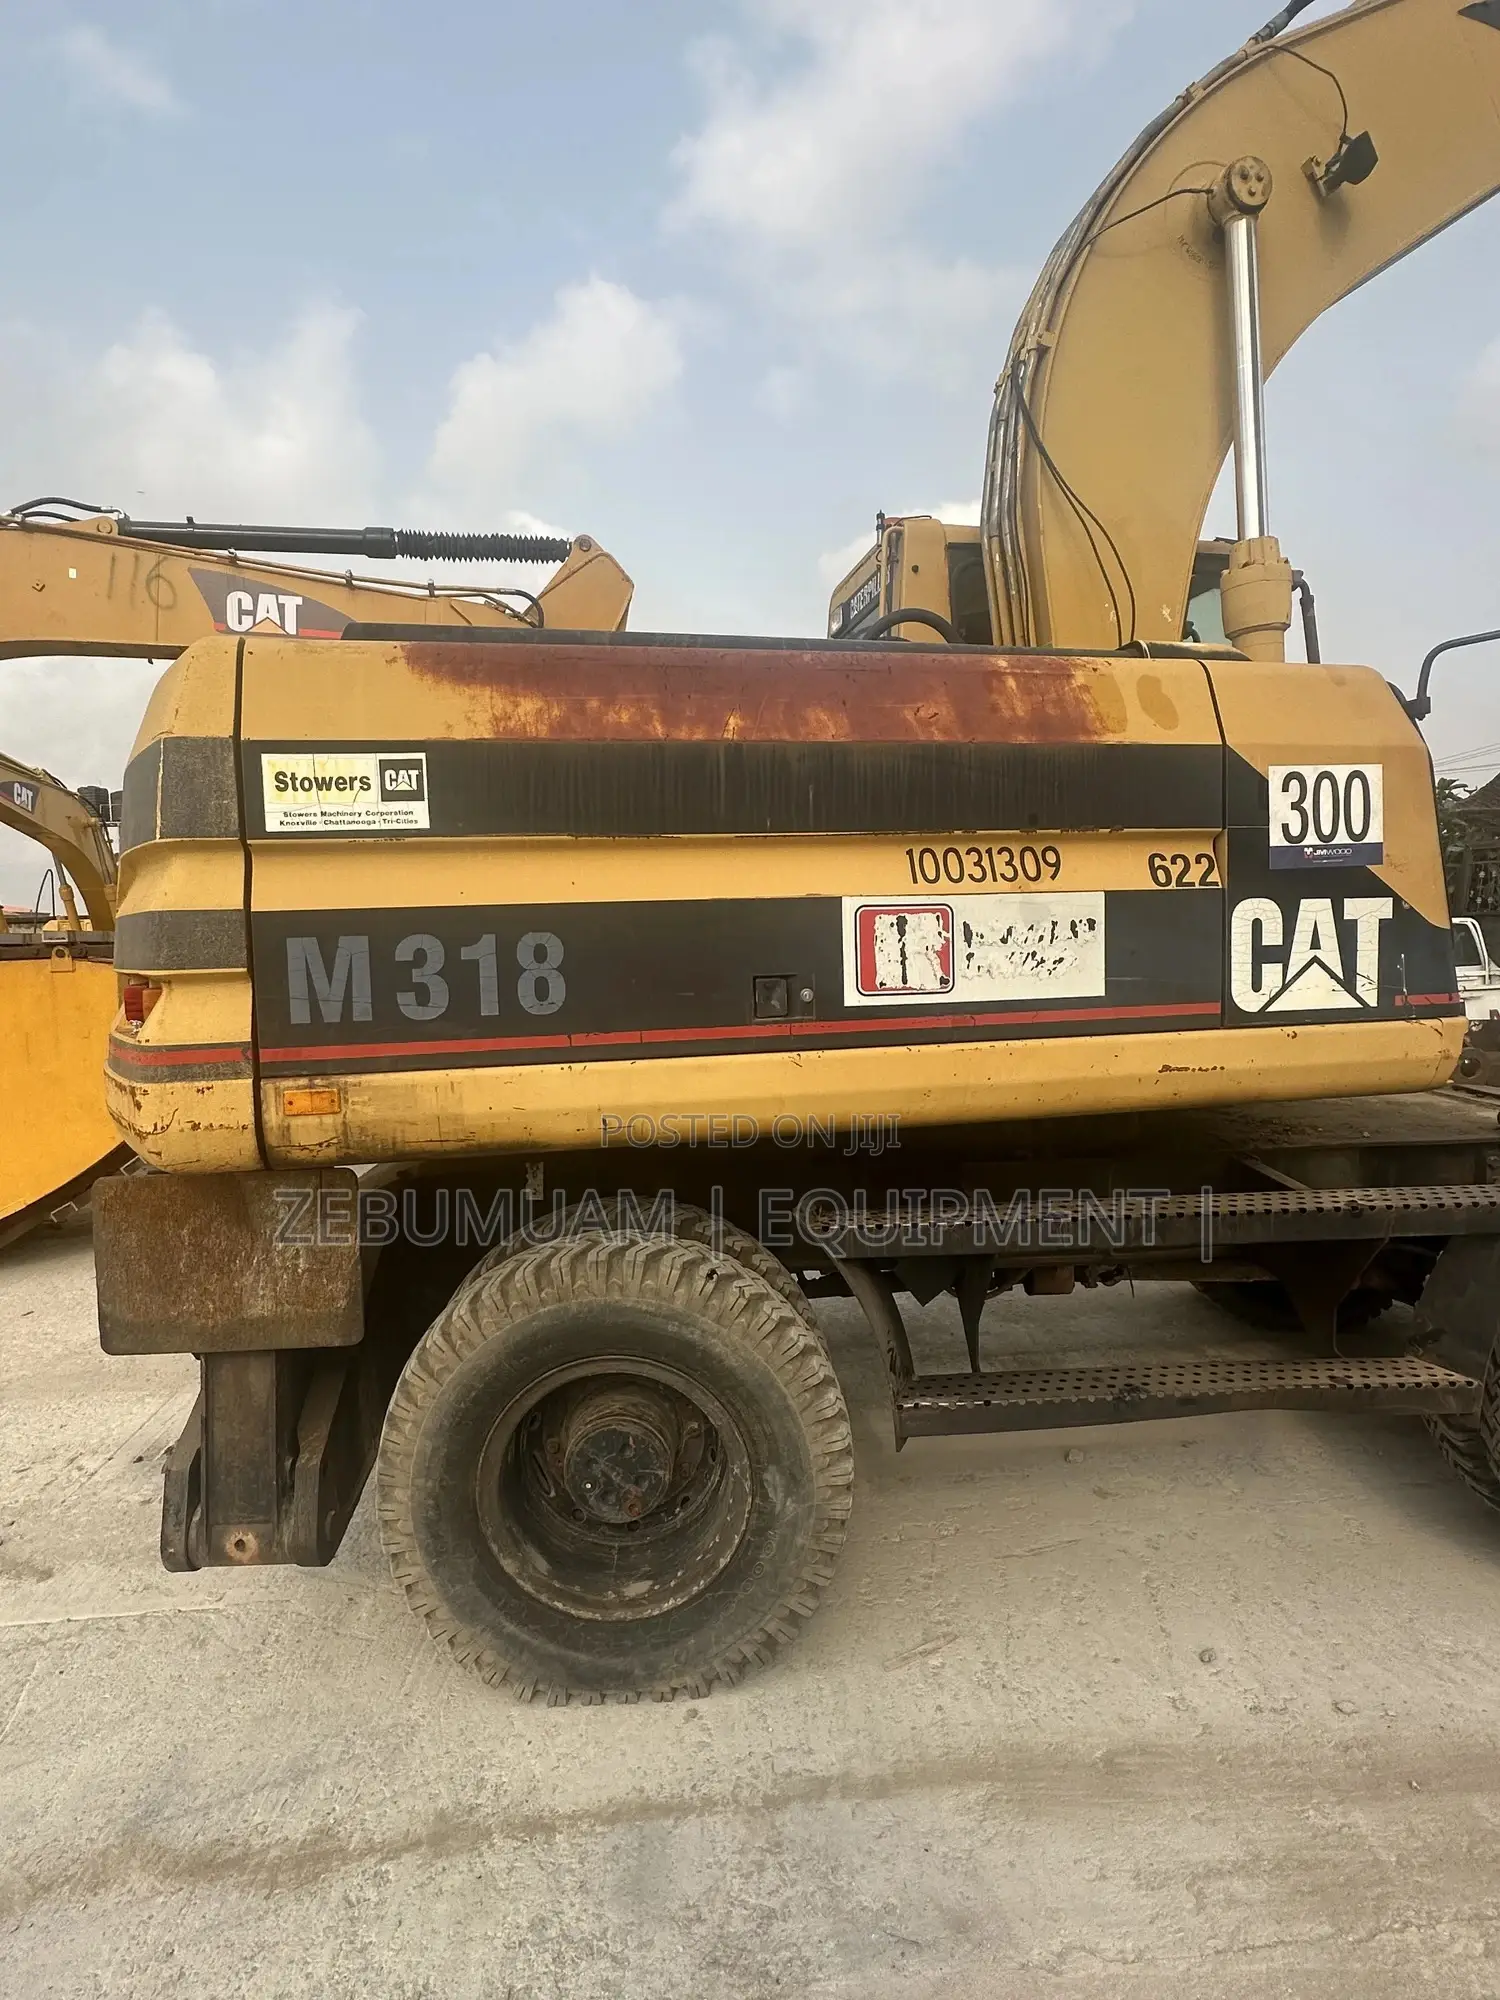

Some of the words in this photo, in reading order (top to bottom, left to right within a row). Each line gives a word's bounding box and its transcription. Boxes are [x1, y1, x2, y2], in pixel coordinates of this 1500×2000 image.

[107, 552, 178, 610] 116
[226, 590, 303, 636] CAT
[13, 782, 34, 812] CAT
[274, 770, 372, 793] Stowers
[384, 769, 420, 791] CAT
[320, 810, 363, 818] Machinery
[323, 818, 377, 827] Chattanooga
[1281, 769, 1371, 845] 300
[905, 846, 1062, 885] 10031309
[1147, 852, 1221, 888] 622
[1231, 897, 1394, 1013] CAT
